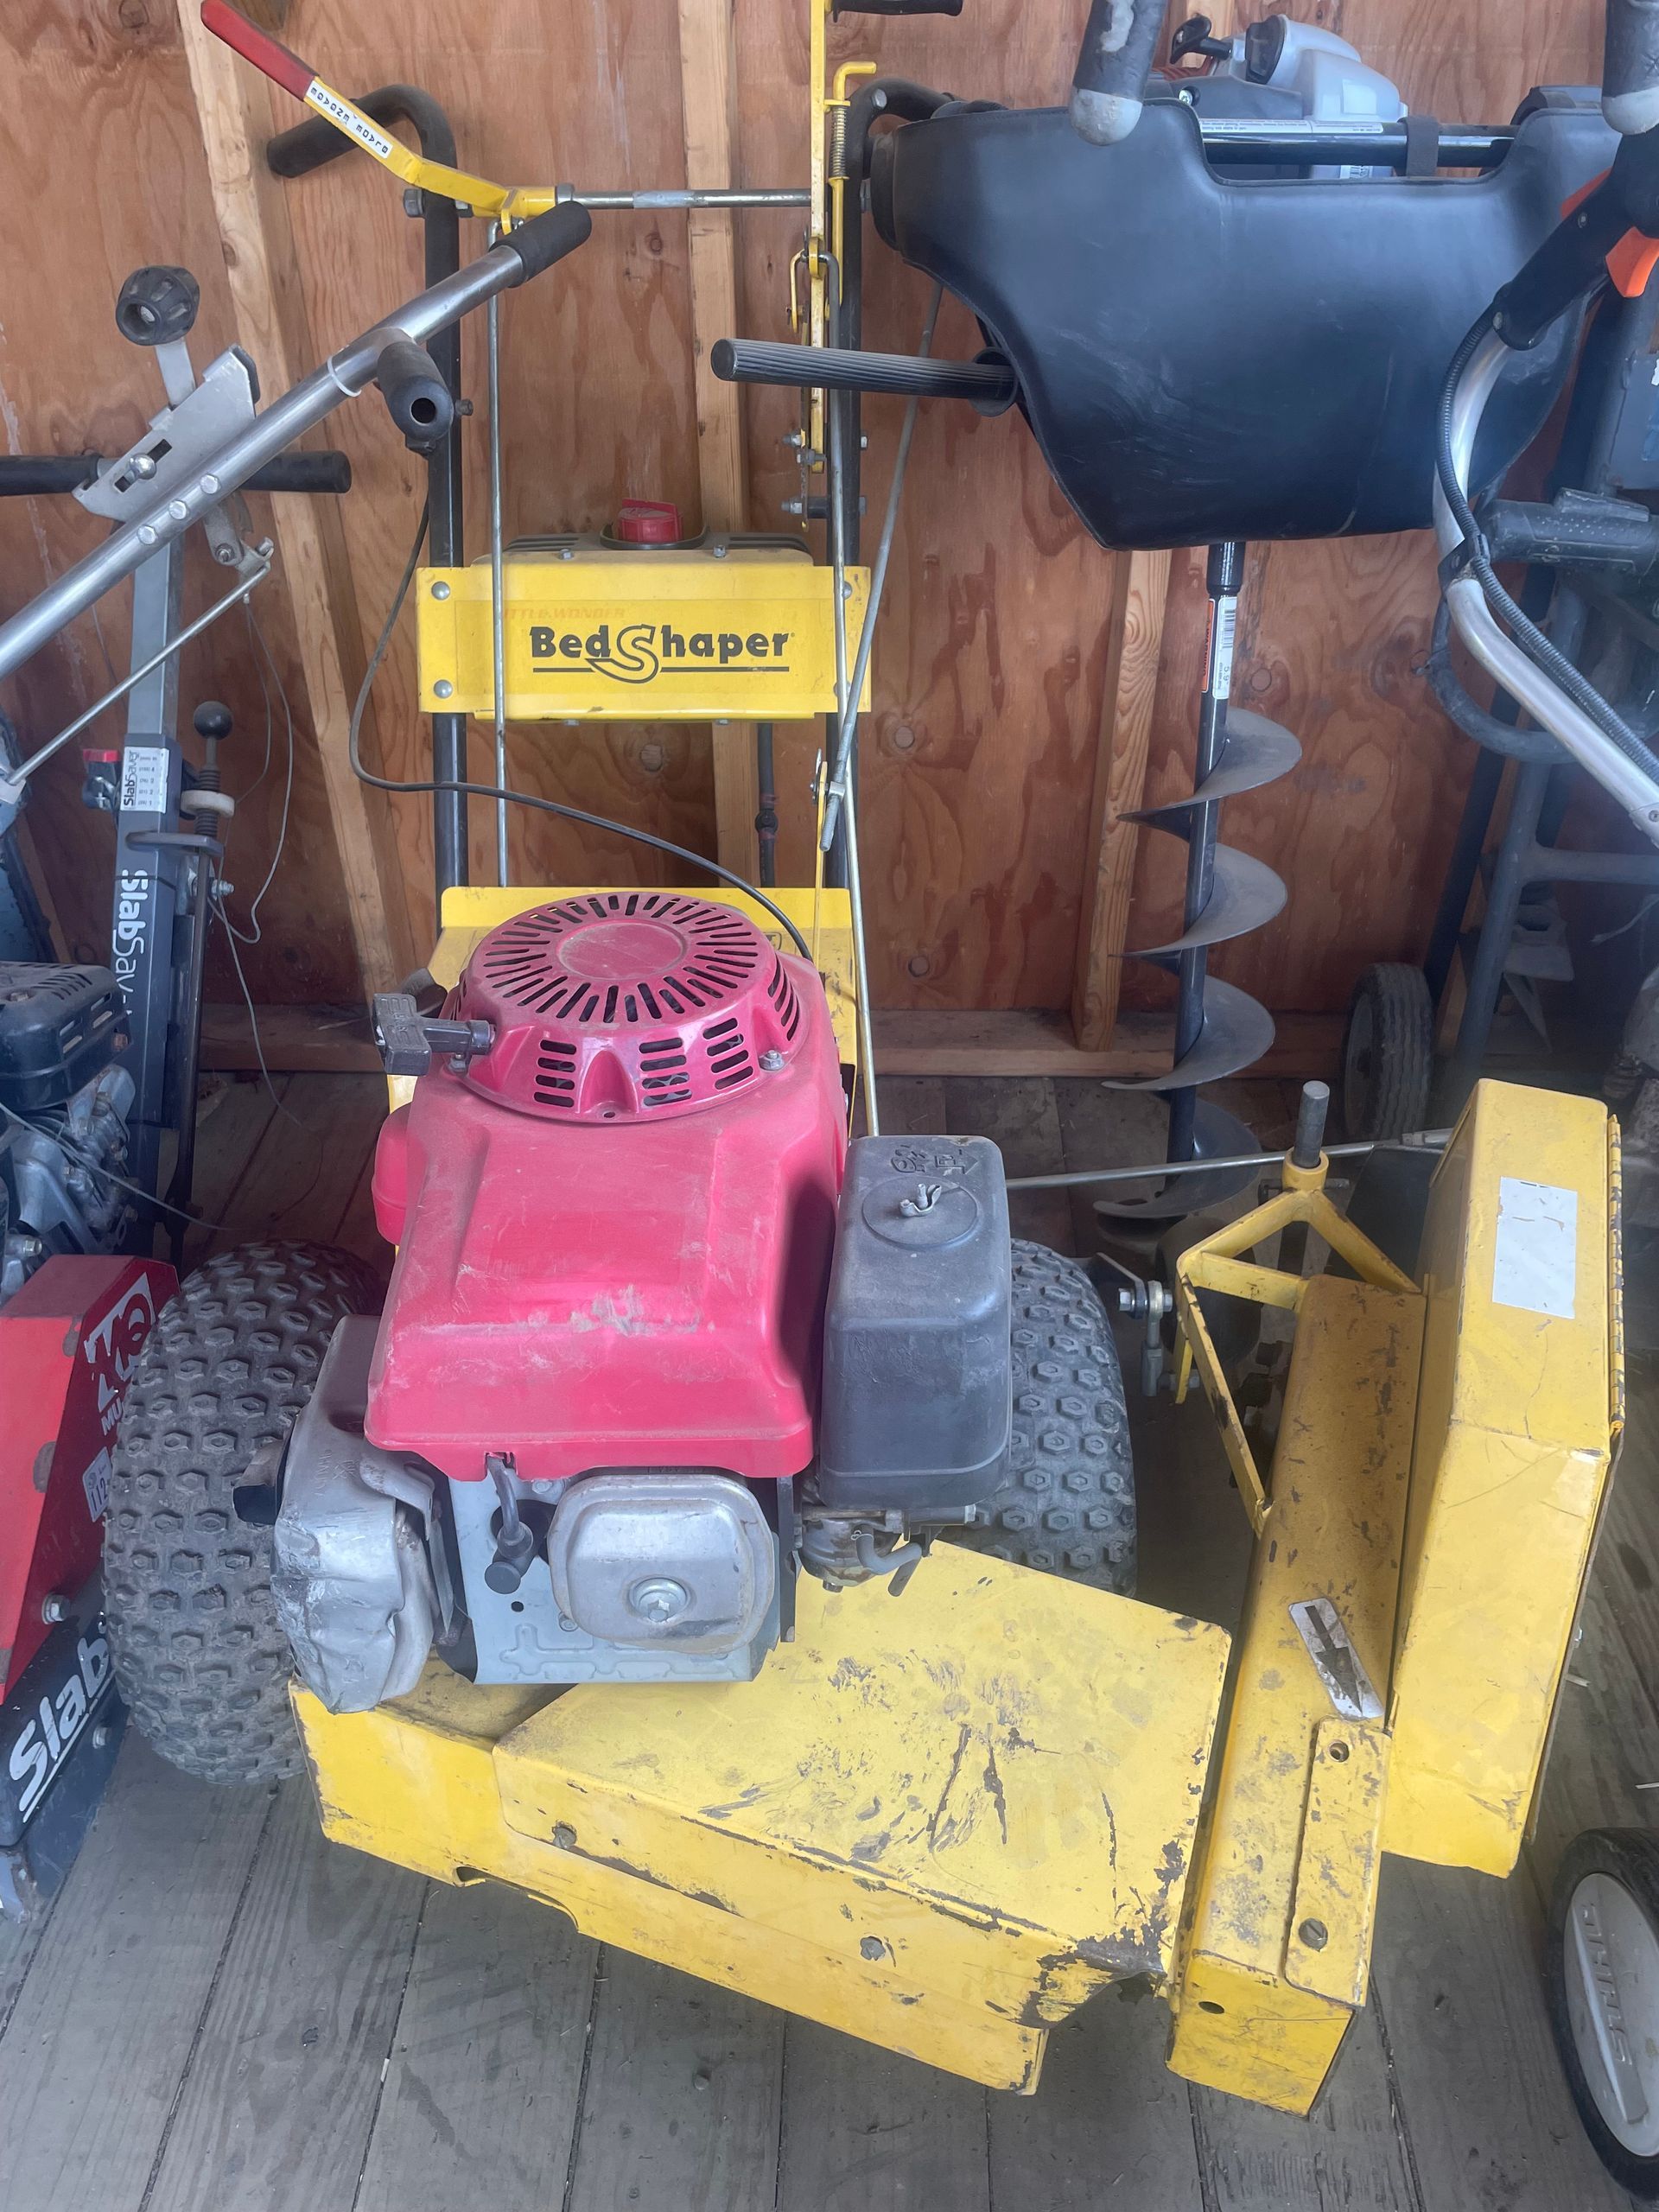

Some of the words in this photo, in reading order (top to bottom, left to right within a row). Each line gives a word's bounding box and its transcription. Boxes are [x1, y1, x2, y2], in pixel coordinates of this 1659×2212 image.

[311, 87, 350, 121] ENGAGE
[356, 124, 388, 154] BLADE
[504, 607, 549, 620] ITTLE
[529, 624, 790, 684] BedShaper
[112, 869, 148, 1014] SlabSav
[101, 1396, 123, 1436] MU
[10, 1633, 109, 1813] Slab
